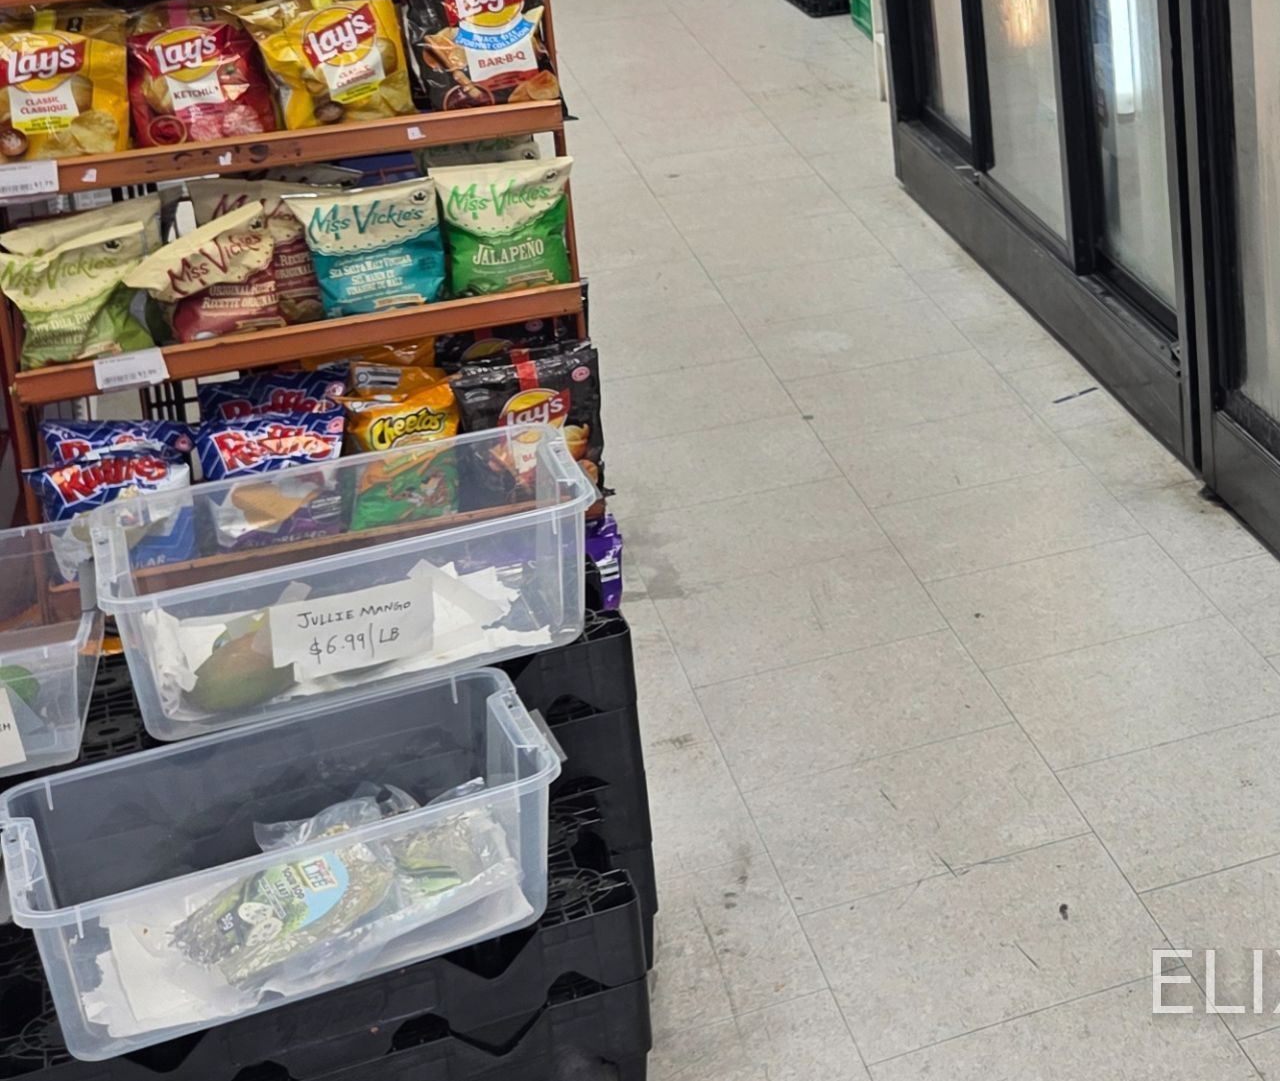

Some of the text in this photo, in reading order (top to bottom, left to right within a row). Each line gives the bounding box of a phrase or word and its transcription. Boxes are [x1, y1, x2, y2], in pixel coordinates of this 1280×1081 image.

[154, 33, 217, 75] Lay's
[308, 11, 374, 64] Lay's
[7, 44, 77, 85] Lay's
[447, 179, 552, 221] Miss Vickie's
[309, 200, 425, 243] Miss Vickie's
[472, 236, 545, 266] JALAPEÑO
[167, 257, 210, 299] Miss
[369, 408, 446, 451] Cheetos
[359, 600, 412, 618] MANGO
